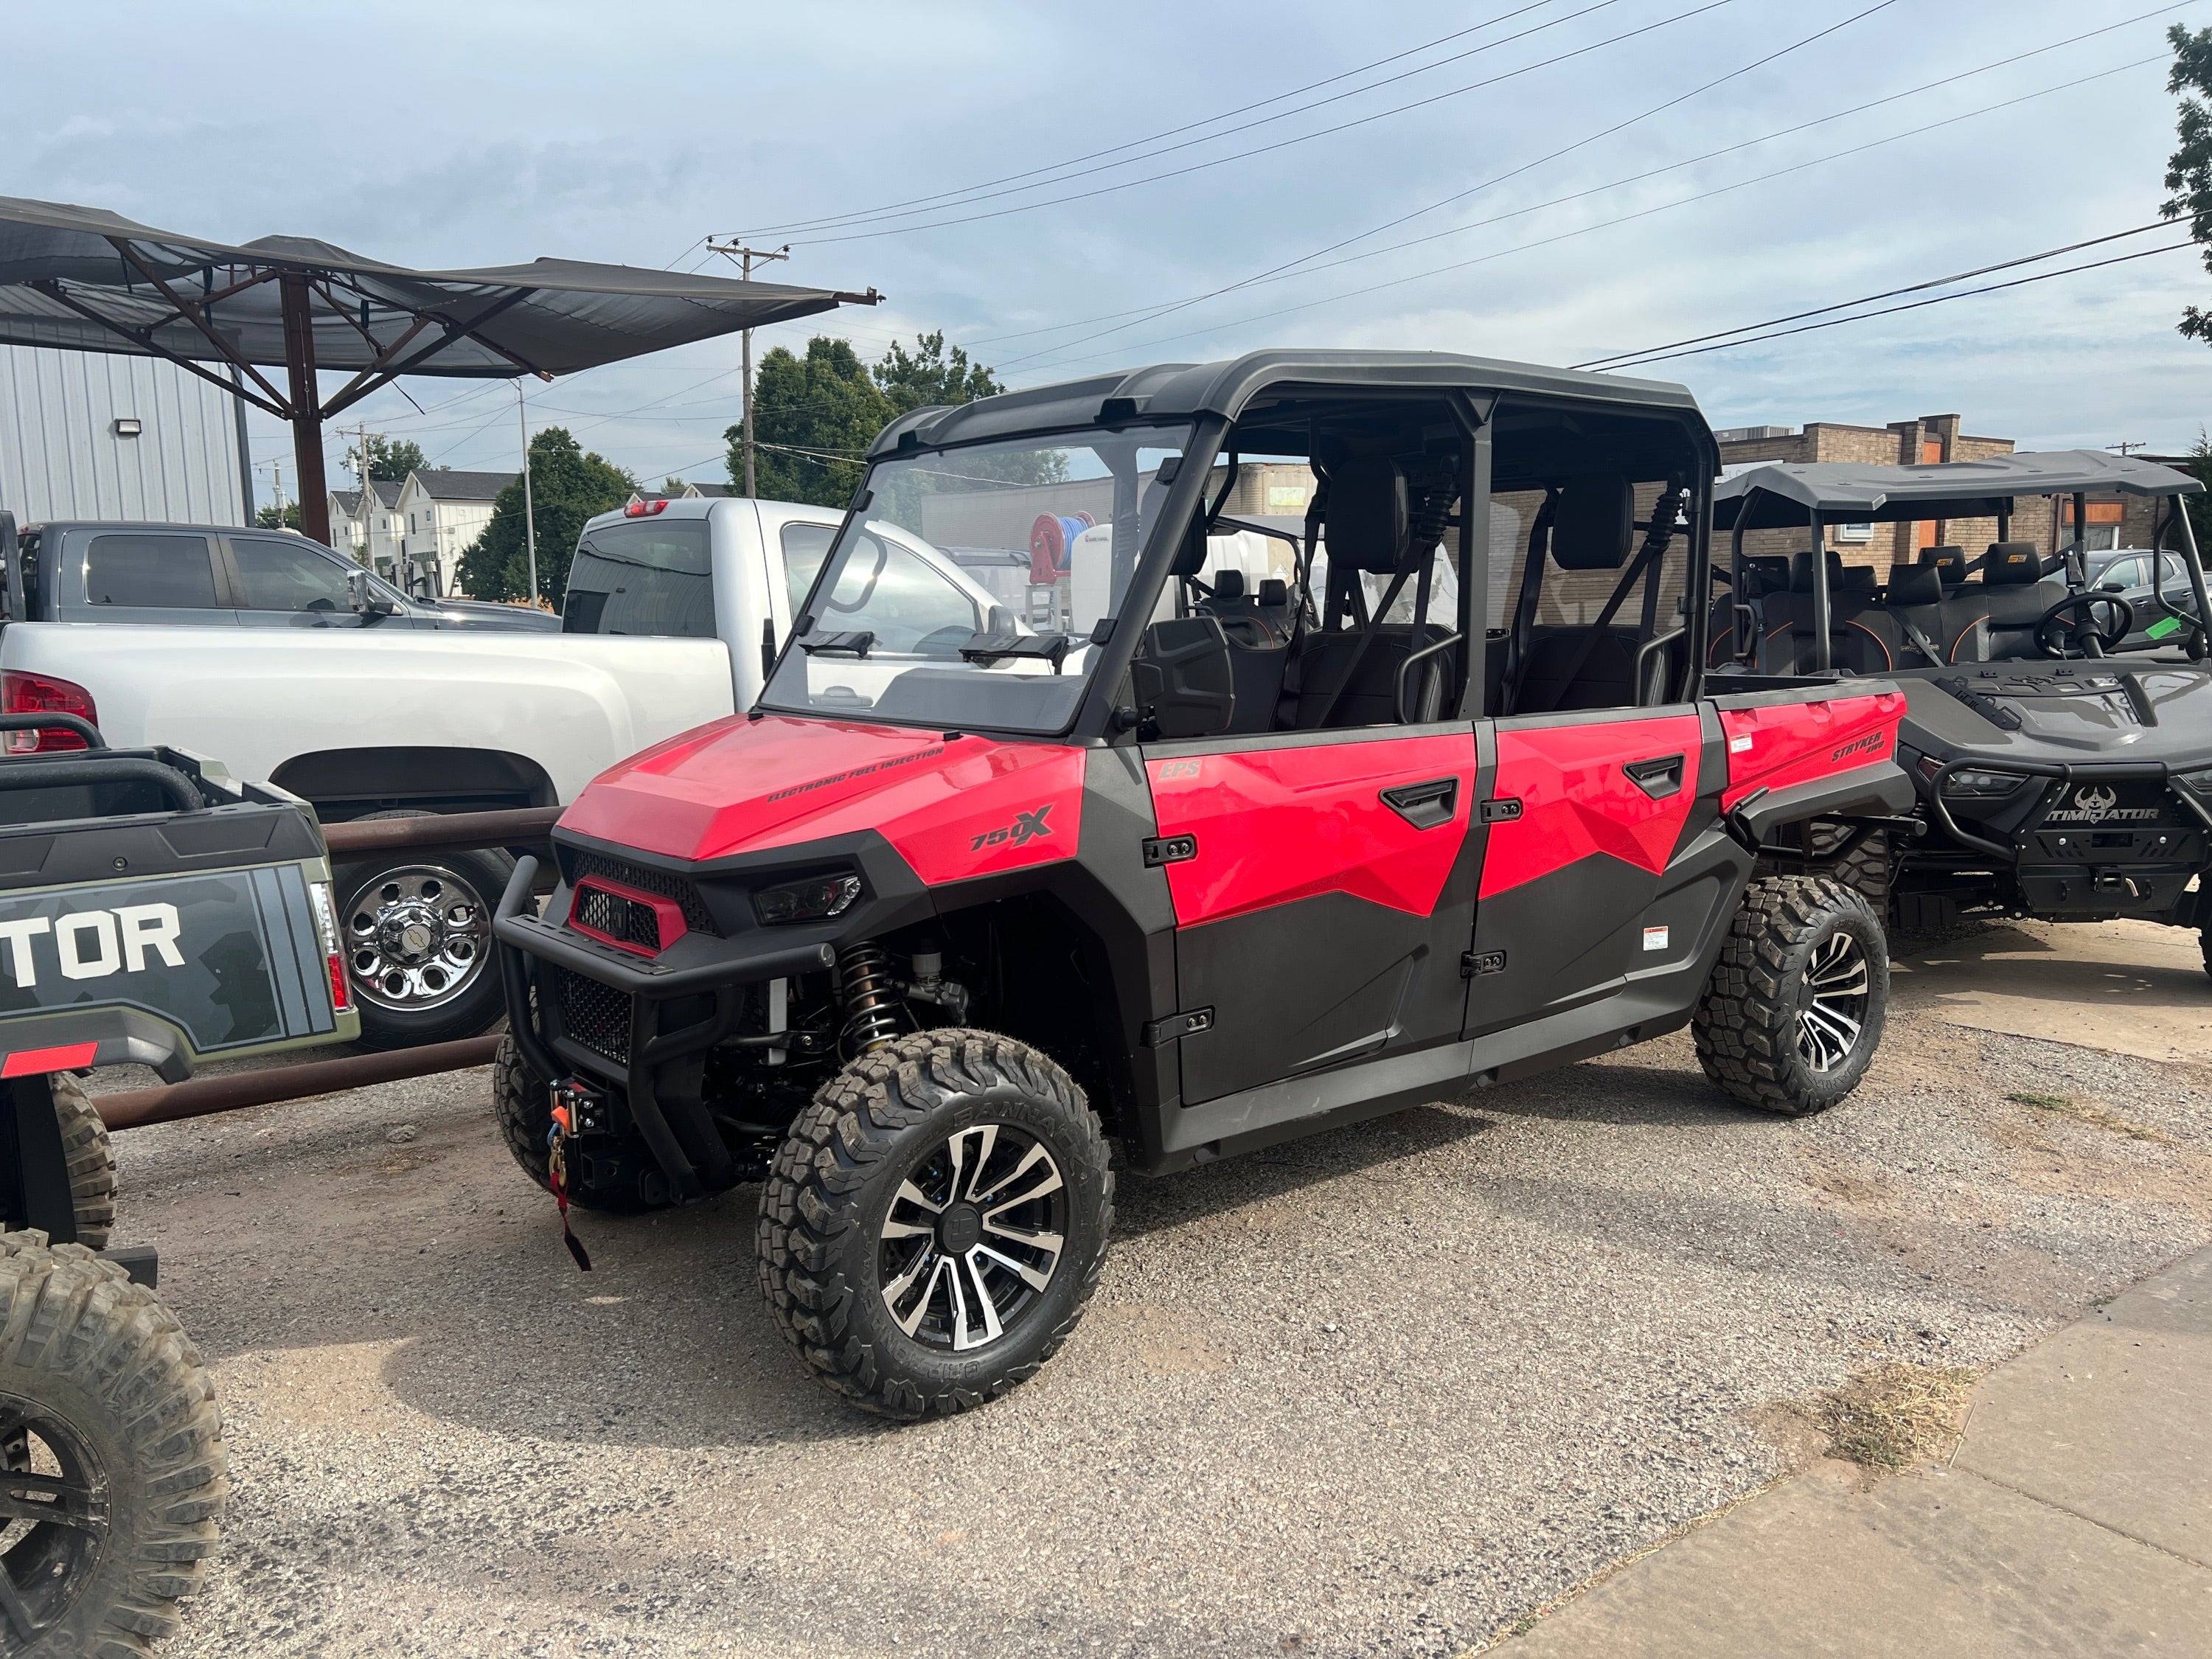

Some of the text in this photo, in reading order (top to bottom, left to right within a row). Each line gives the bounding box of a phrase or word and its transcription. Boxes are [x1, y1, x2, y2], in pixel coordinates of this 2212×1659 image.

[1832, 731, 1882, 762] STRYKER
[1865, 740, 1885, 754] 4WD
[768, 747, 945, 803] ELECTRONIC FUEL INJECTION
[1159, 761, 1201, 779] EPS
[970, 804, 1054, 852] 750X
[2045, 809, 2160, 824] TIMIDATOR
[0, 902, 185, 987] TOR
